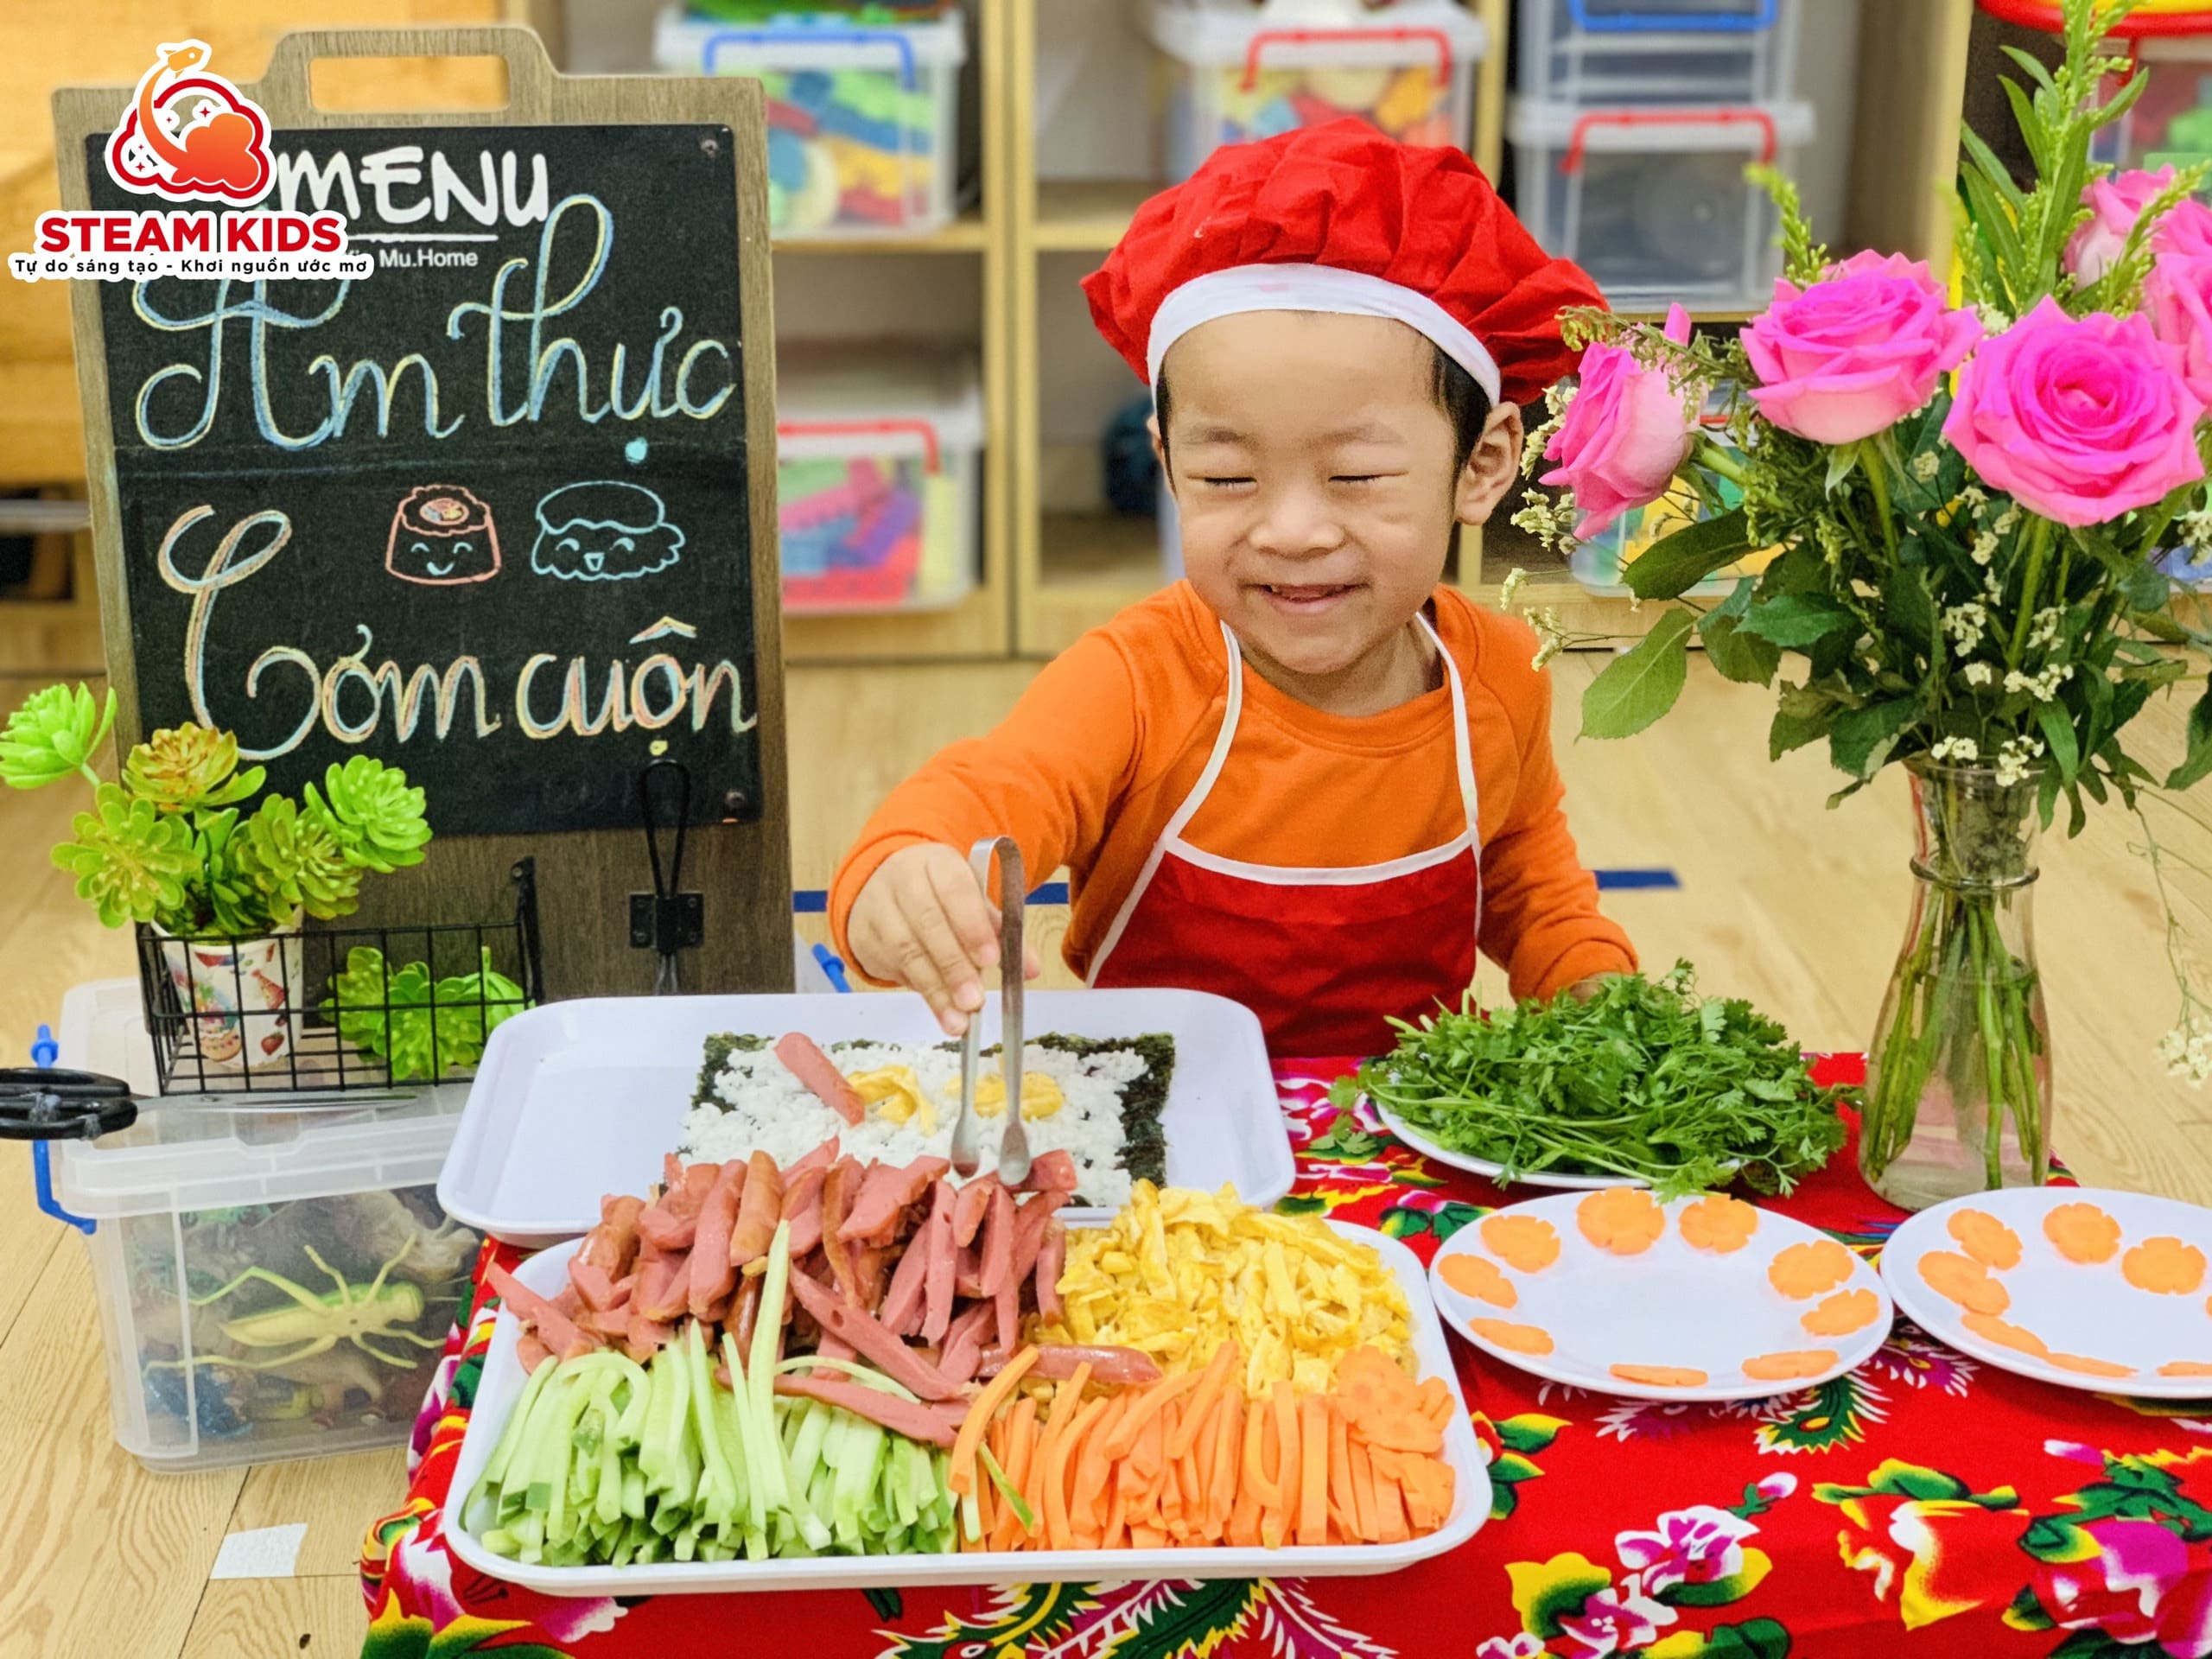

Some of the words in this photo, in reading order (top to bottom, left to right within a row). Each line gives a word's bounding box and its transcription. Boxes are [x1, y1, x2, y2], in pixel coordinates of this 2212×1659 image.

[277, 145, 550, 227] MENU
[378, 248, 479, 268] Mu.Home
[446, 195, 736, 464] thực
[158, 504, 501, 762] Cơm
[516, 616, 758, 756] cuộn
